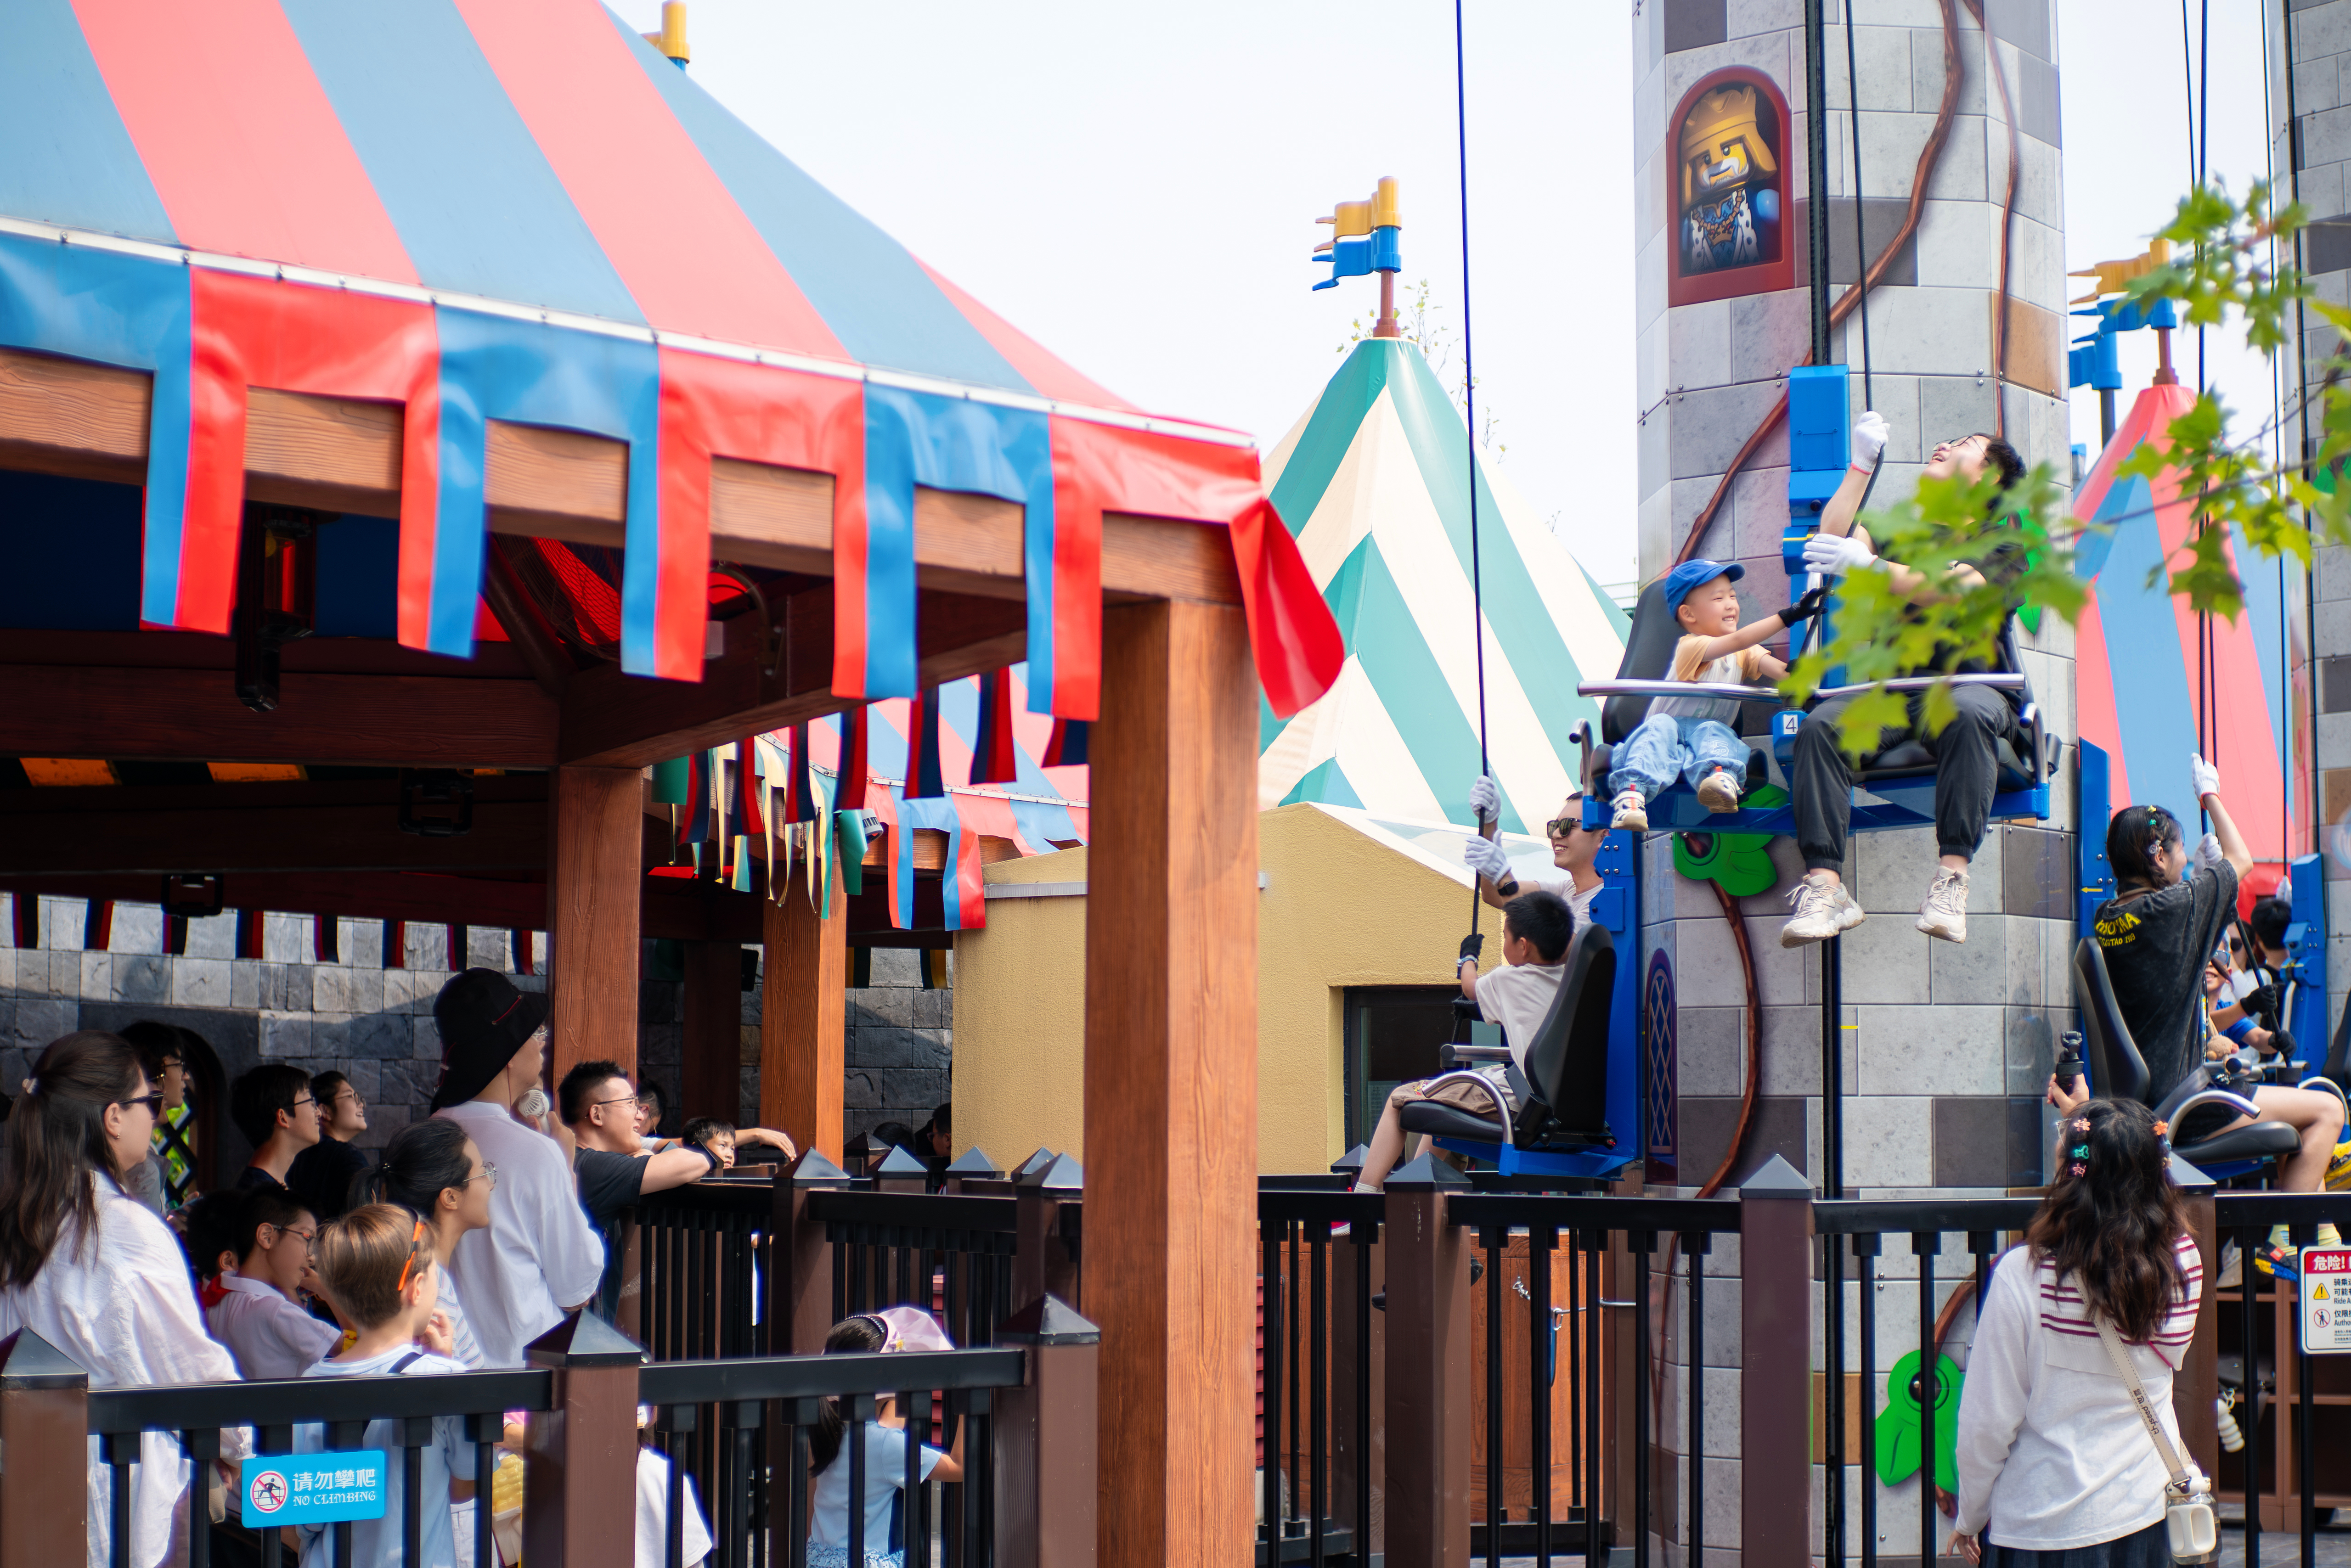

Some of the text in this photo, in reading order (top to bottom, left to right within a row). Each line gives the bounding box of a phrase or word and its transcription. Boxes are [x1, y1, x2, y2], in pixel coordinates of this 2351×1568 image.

[1786, 717, 1797, 733] 4
[2314, 1254, 2345, 1270] 危险!
[2133, 1388, 2159, 1435] thyseed 世喜
[292, 1469, 376, 1492] 请勿攀爬
[293, 1491, 376, 1506] NO CLIMBING
